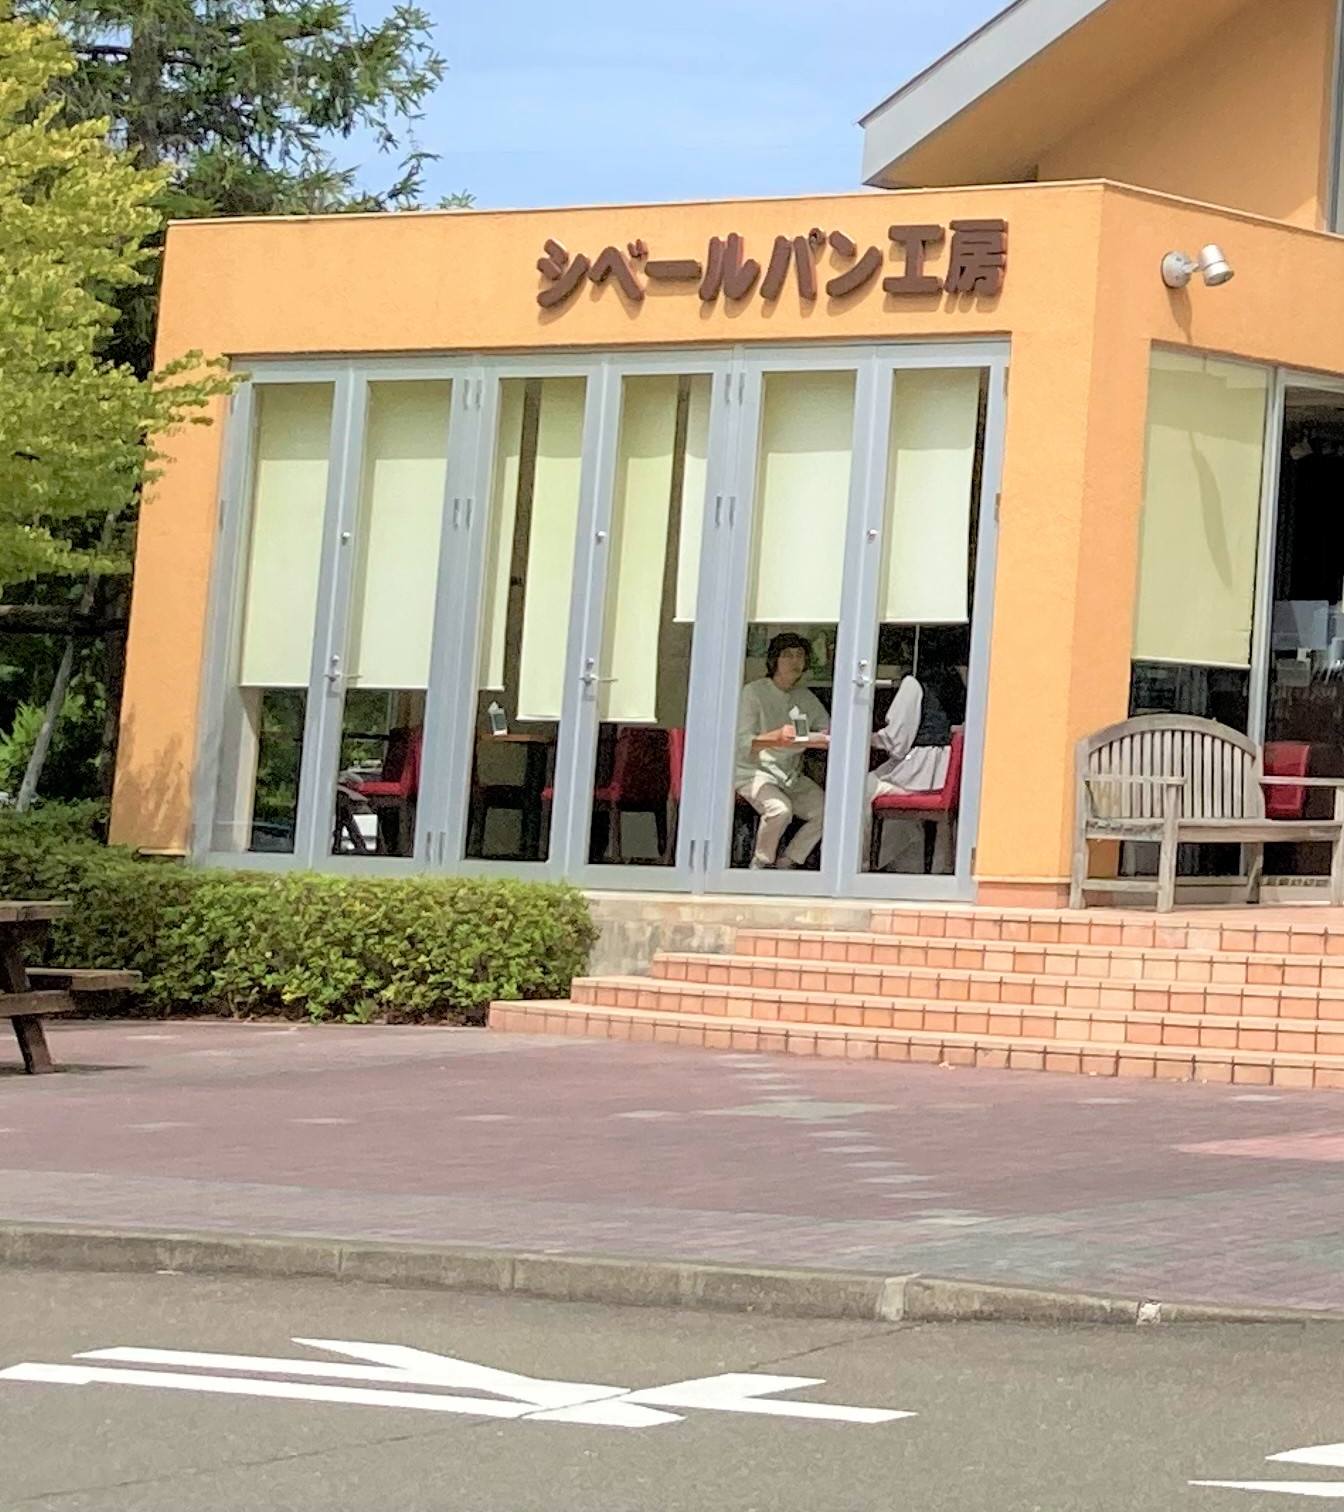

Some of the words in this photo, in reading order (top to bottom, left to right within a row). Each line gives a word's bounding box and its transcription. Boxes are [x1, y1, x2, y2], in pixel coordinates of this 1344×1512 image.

[537, 218, 1008, 308] シベールパン工房
